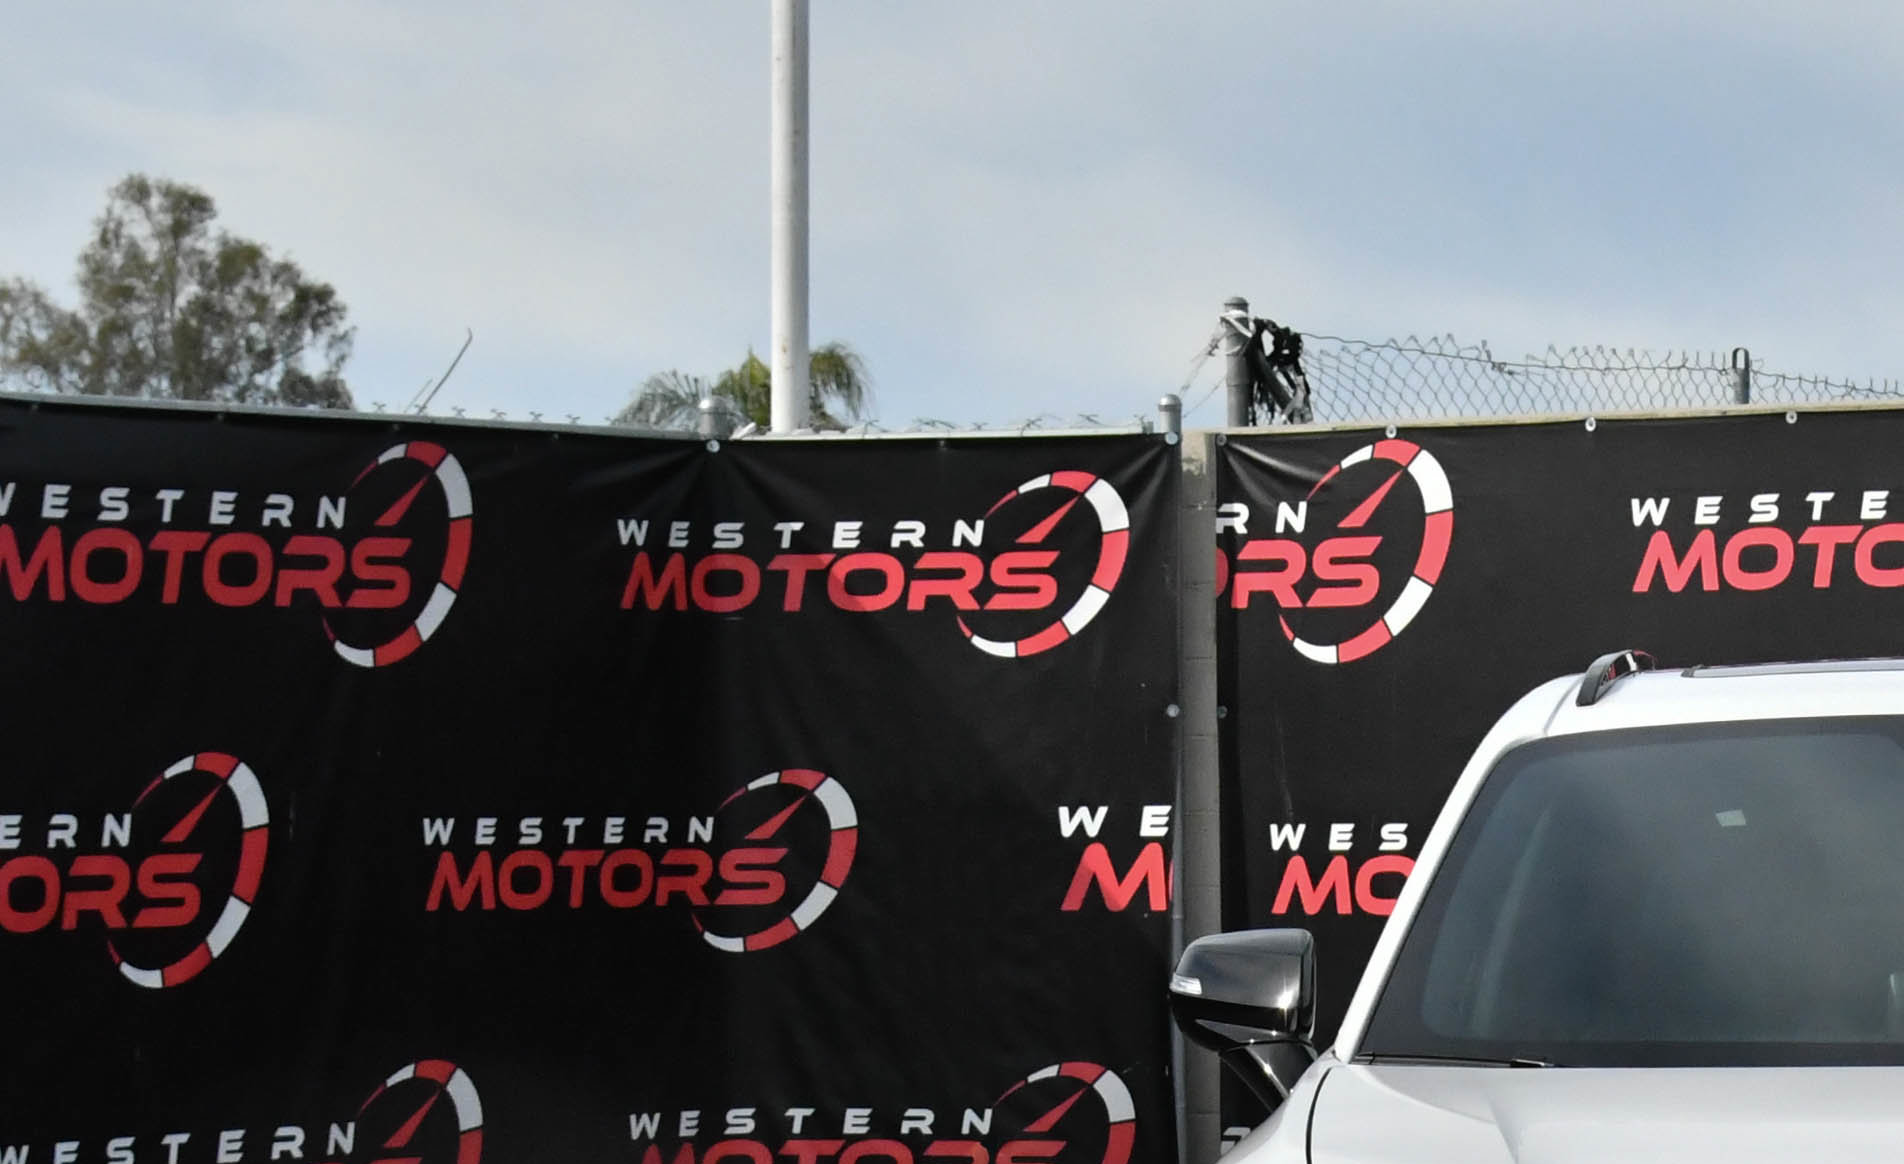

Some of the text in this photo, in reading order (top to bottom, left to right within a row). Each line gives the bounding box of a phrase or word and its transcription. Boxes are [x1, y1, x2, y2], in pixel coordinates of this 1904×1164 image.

[0, 523, 412, 608] MOTORS
[617, 519, 985, 549] WESTERN
[620, 550, 1061, 613] MOTORS
[1216, 536, 1383, 609] RS
[423, 817, 715, 845] WESTERN
[1058, 805, 1172, 838] WE
[1269, 823, 1409, 851] WES
[425, 848, 789, 912] MOTORS
[1060, 841, 1174, 912] M
[1271, 854, 1417, 917] MO
[629, 1108, 993, 1140] WESTERN
